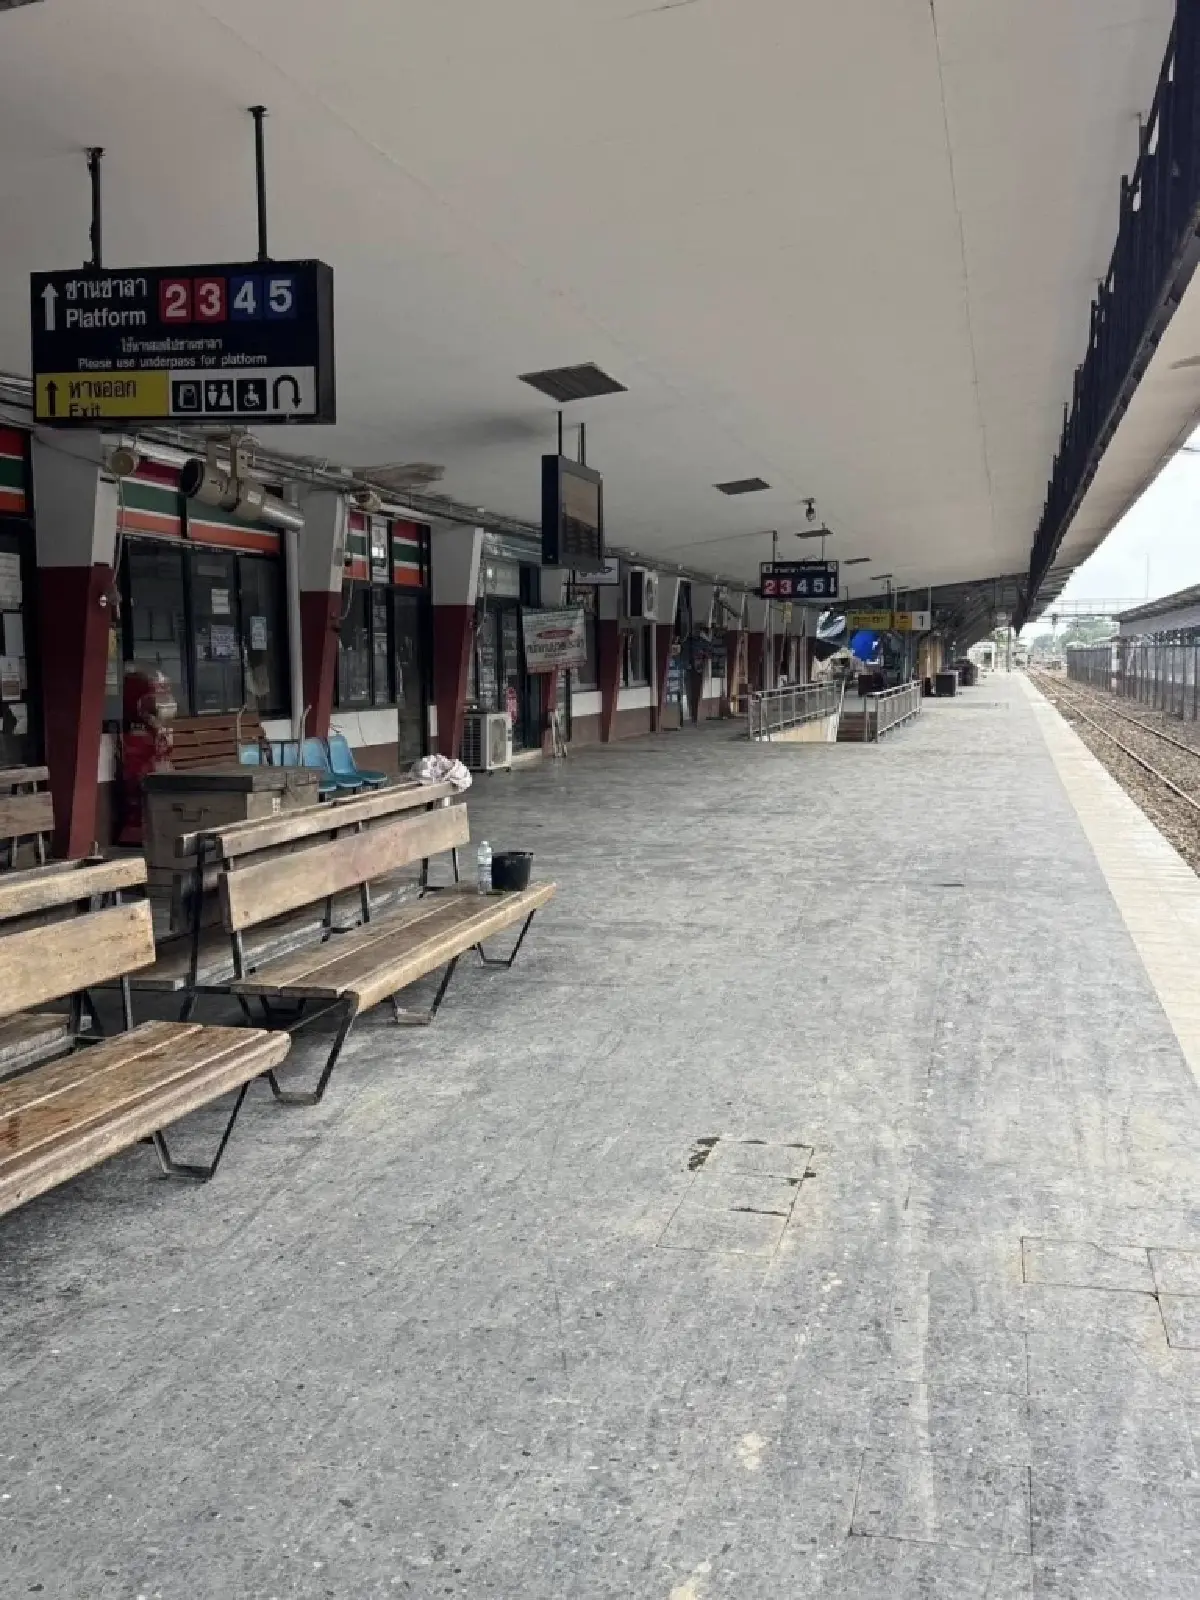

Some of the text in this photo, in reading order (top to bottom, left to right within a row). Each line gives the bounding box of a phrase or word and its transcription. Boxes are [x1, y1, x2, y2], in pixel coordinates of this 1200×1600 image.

[65, 277, 148, 300] ชานชาลา
[165, 279, 292, 317] 2 3 4 5
[66, 308, 147, 328] Platform
[78, 353, 267, 369] Please use underpass for platform
[69, 380, 137, 398] ทางออก
[69, 402, 101, 418] Exit
[764, 578, 824, 595] 2 3 4 5
